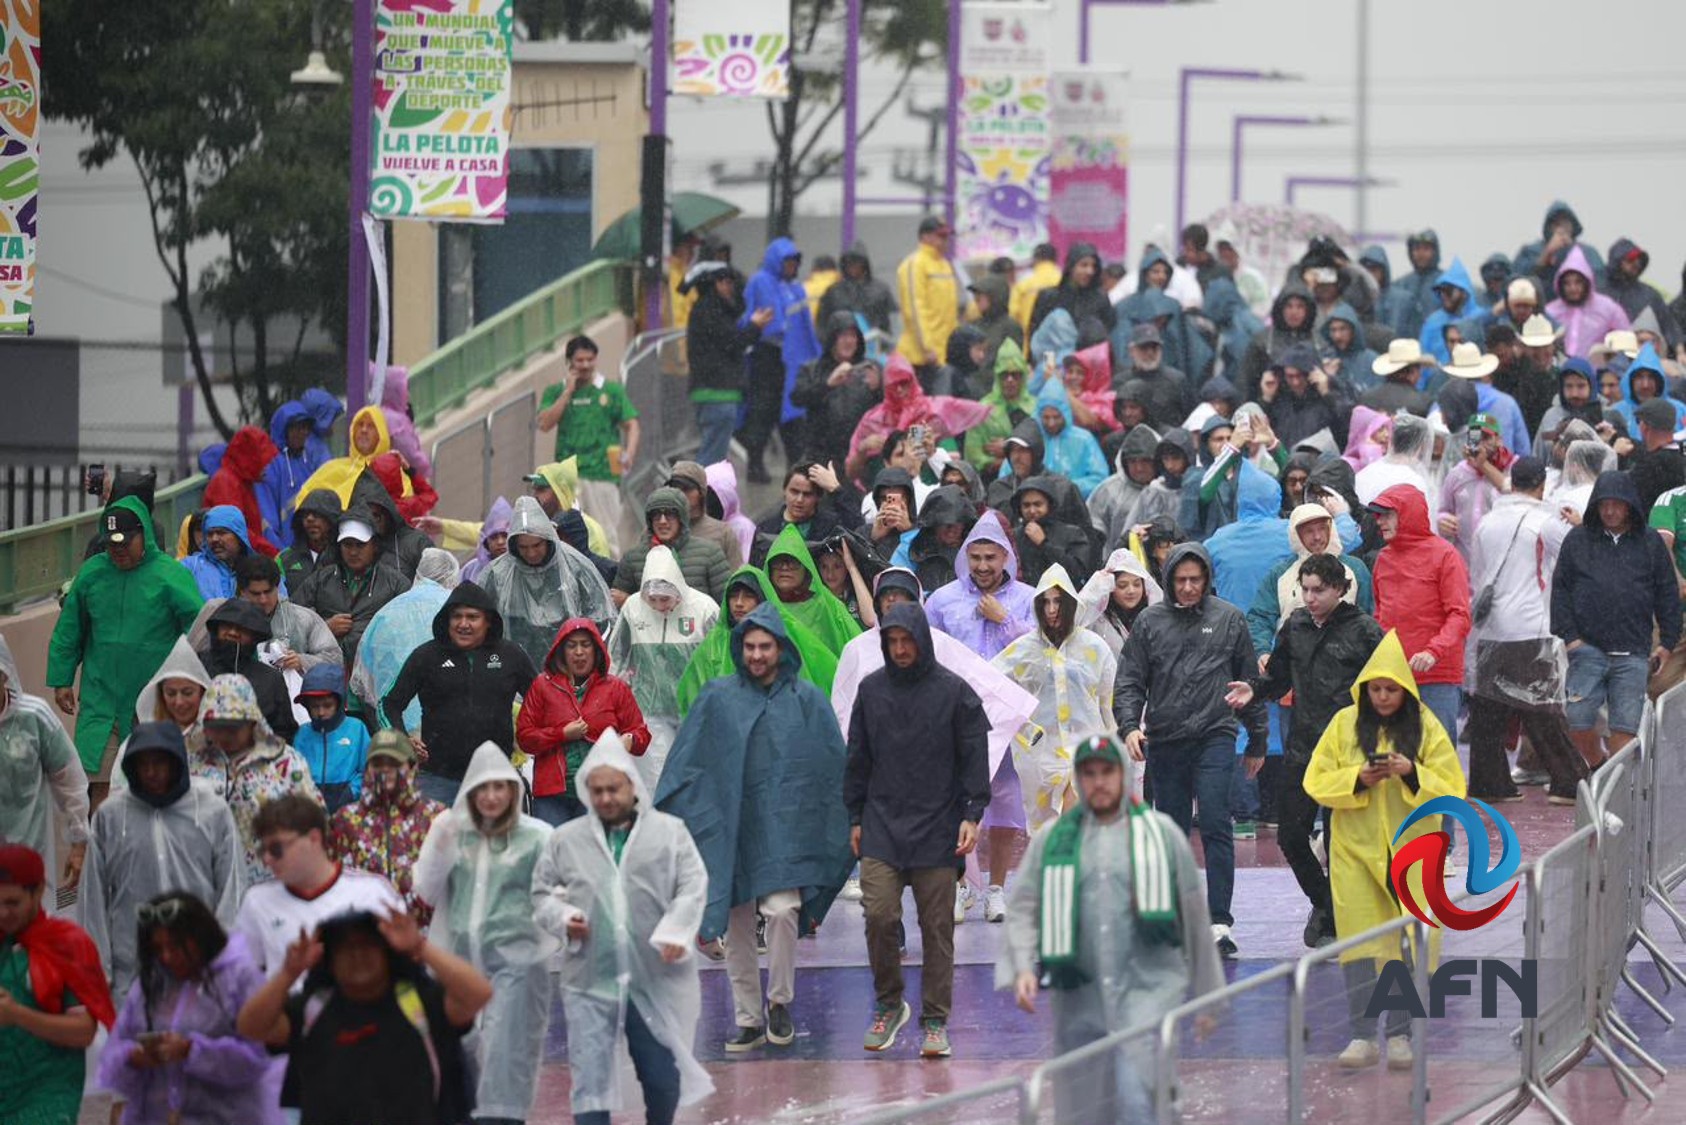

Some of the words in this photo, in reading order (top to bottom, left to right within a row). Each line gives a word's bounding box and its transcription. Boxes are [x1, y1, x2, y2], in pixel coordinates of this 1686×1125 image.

[393, 13, 416, 27] UN
[426, 14, 499, 29] MUNDIAL
[387, 34, 420, 49] QUE
[430, 35, 486, 49] MUEVE
[494, 37, 506, 50] A
[384, 55, 415, 69] LAS
[423, 55, 508, 70] PERSONAS
[385, 75, 396, 90] A
[475, 76, 504, 91] DEL
[408, 93, 482, 109] DEPORTE
[383, 133, 411, 152] LA
[416, 134, 499, 154] PELOTA
[383, 156, 440, 171] VUELVE
[444, 158, 455, 171] A
[460, 158, 499, 172] CASA
